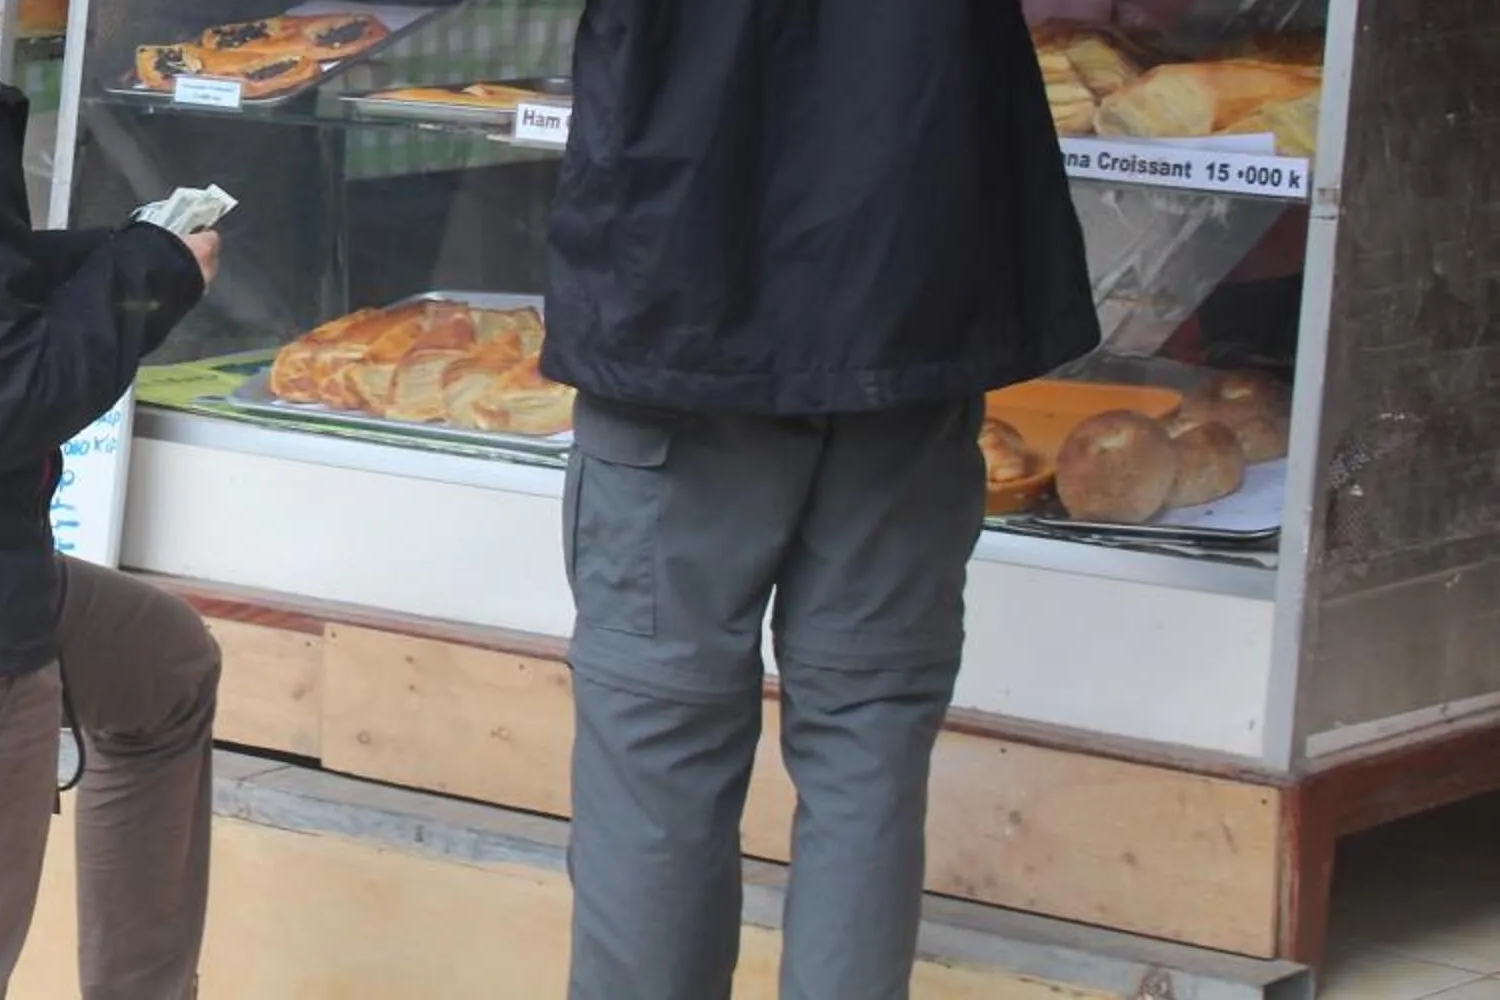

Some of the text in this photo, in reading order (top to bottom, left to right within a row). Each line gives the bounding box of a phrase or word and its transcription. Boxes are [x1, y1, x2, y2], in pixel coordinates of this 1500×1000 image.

[522, 107, 562, 129] Ham
[1096, 151, 1193, 180] Croissant
[1205, 161, 1231, 183] 15
